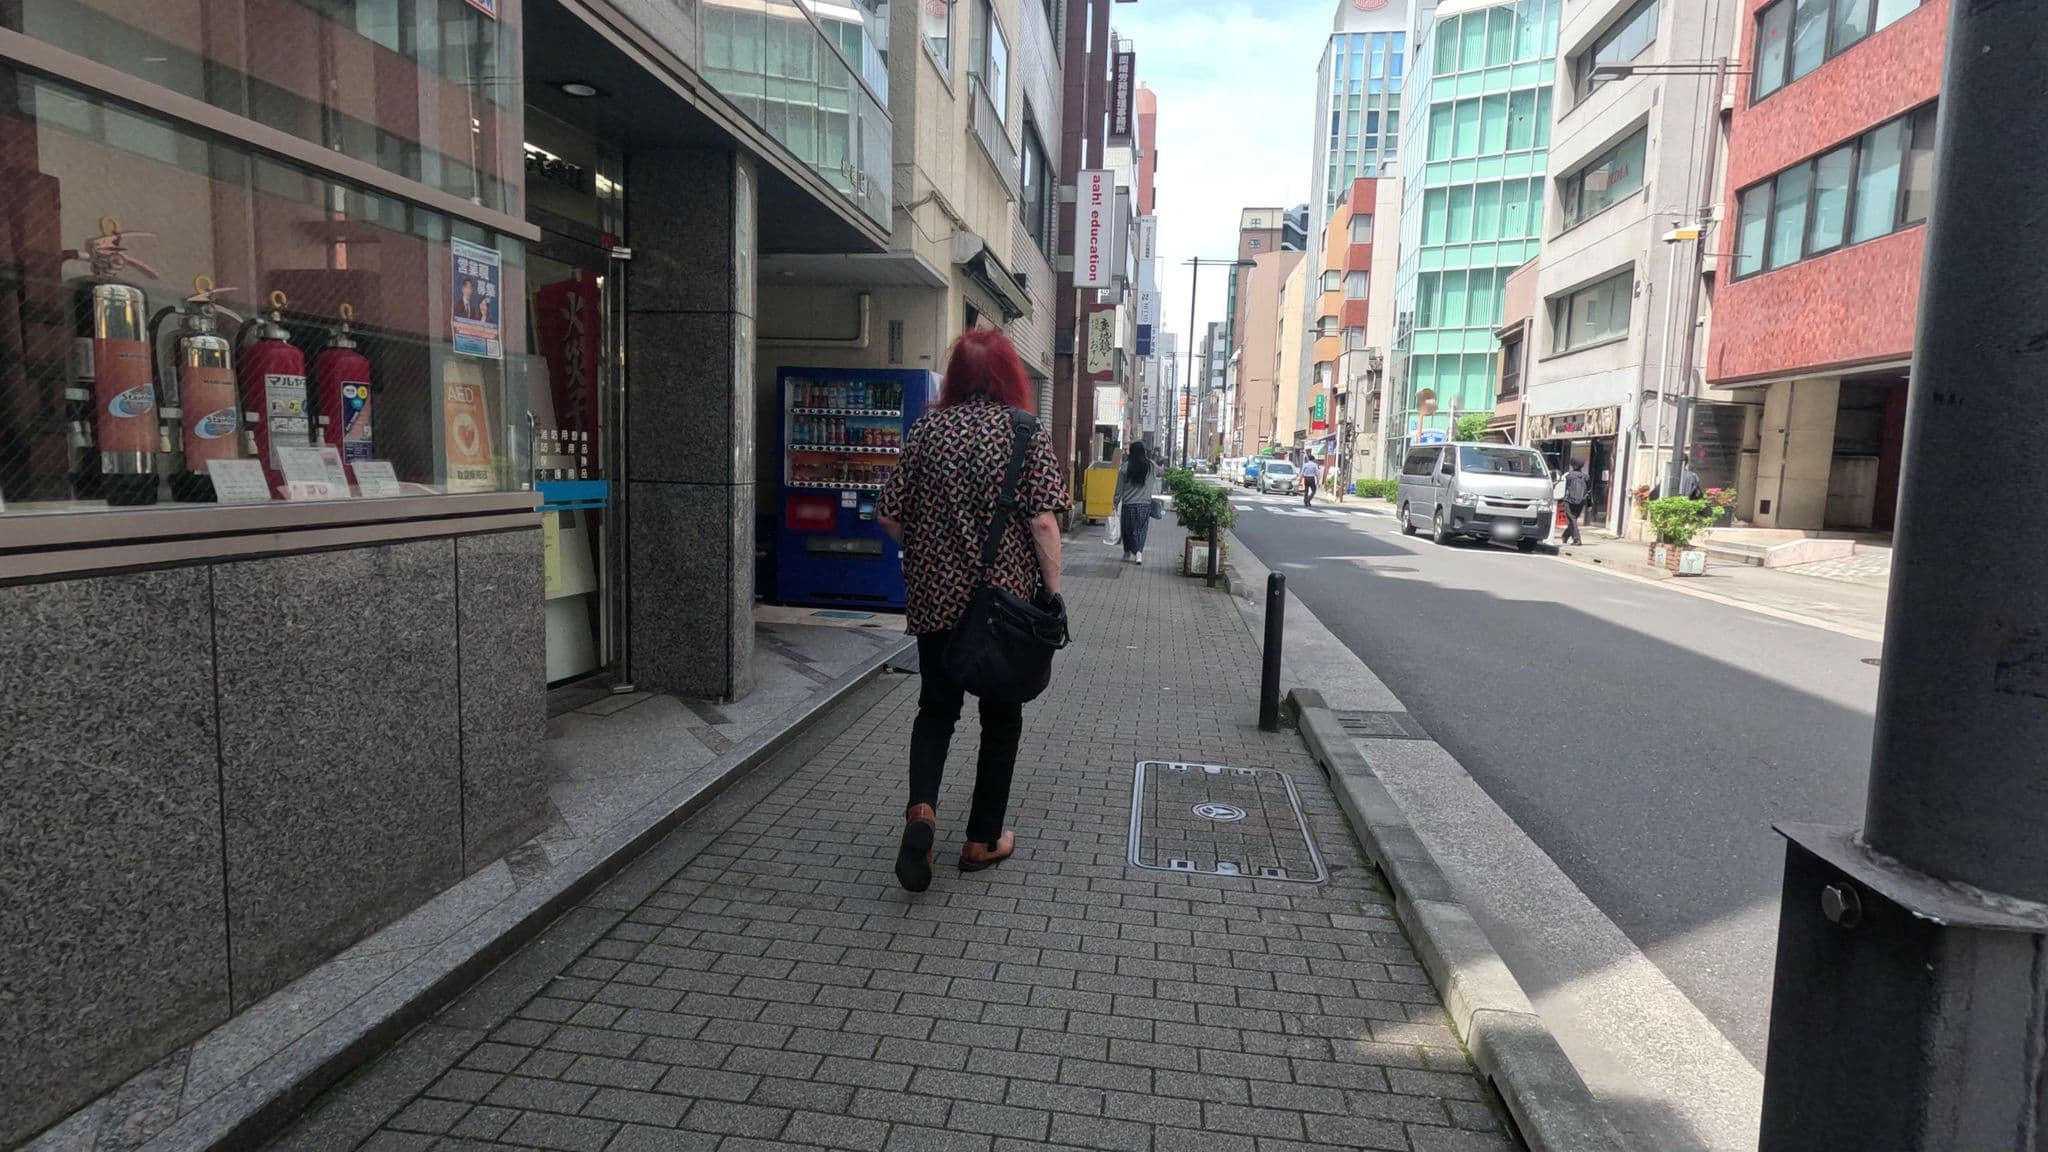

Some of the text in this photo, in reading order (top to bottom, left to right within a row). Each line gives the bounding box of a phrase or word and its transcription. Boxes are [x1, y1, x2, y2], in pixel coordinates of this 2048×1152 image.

[1089, 175, 1102, 281] aah! education
[448, 386, 474, 403] AED
